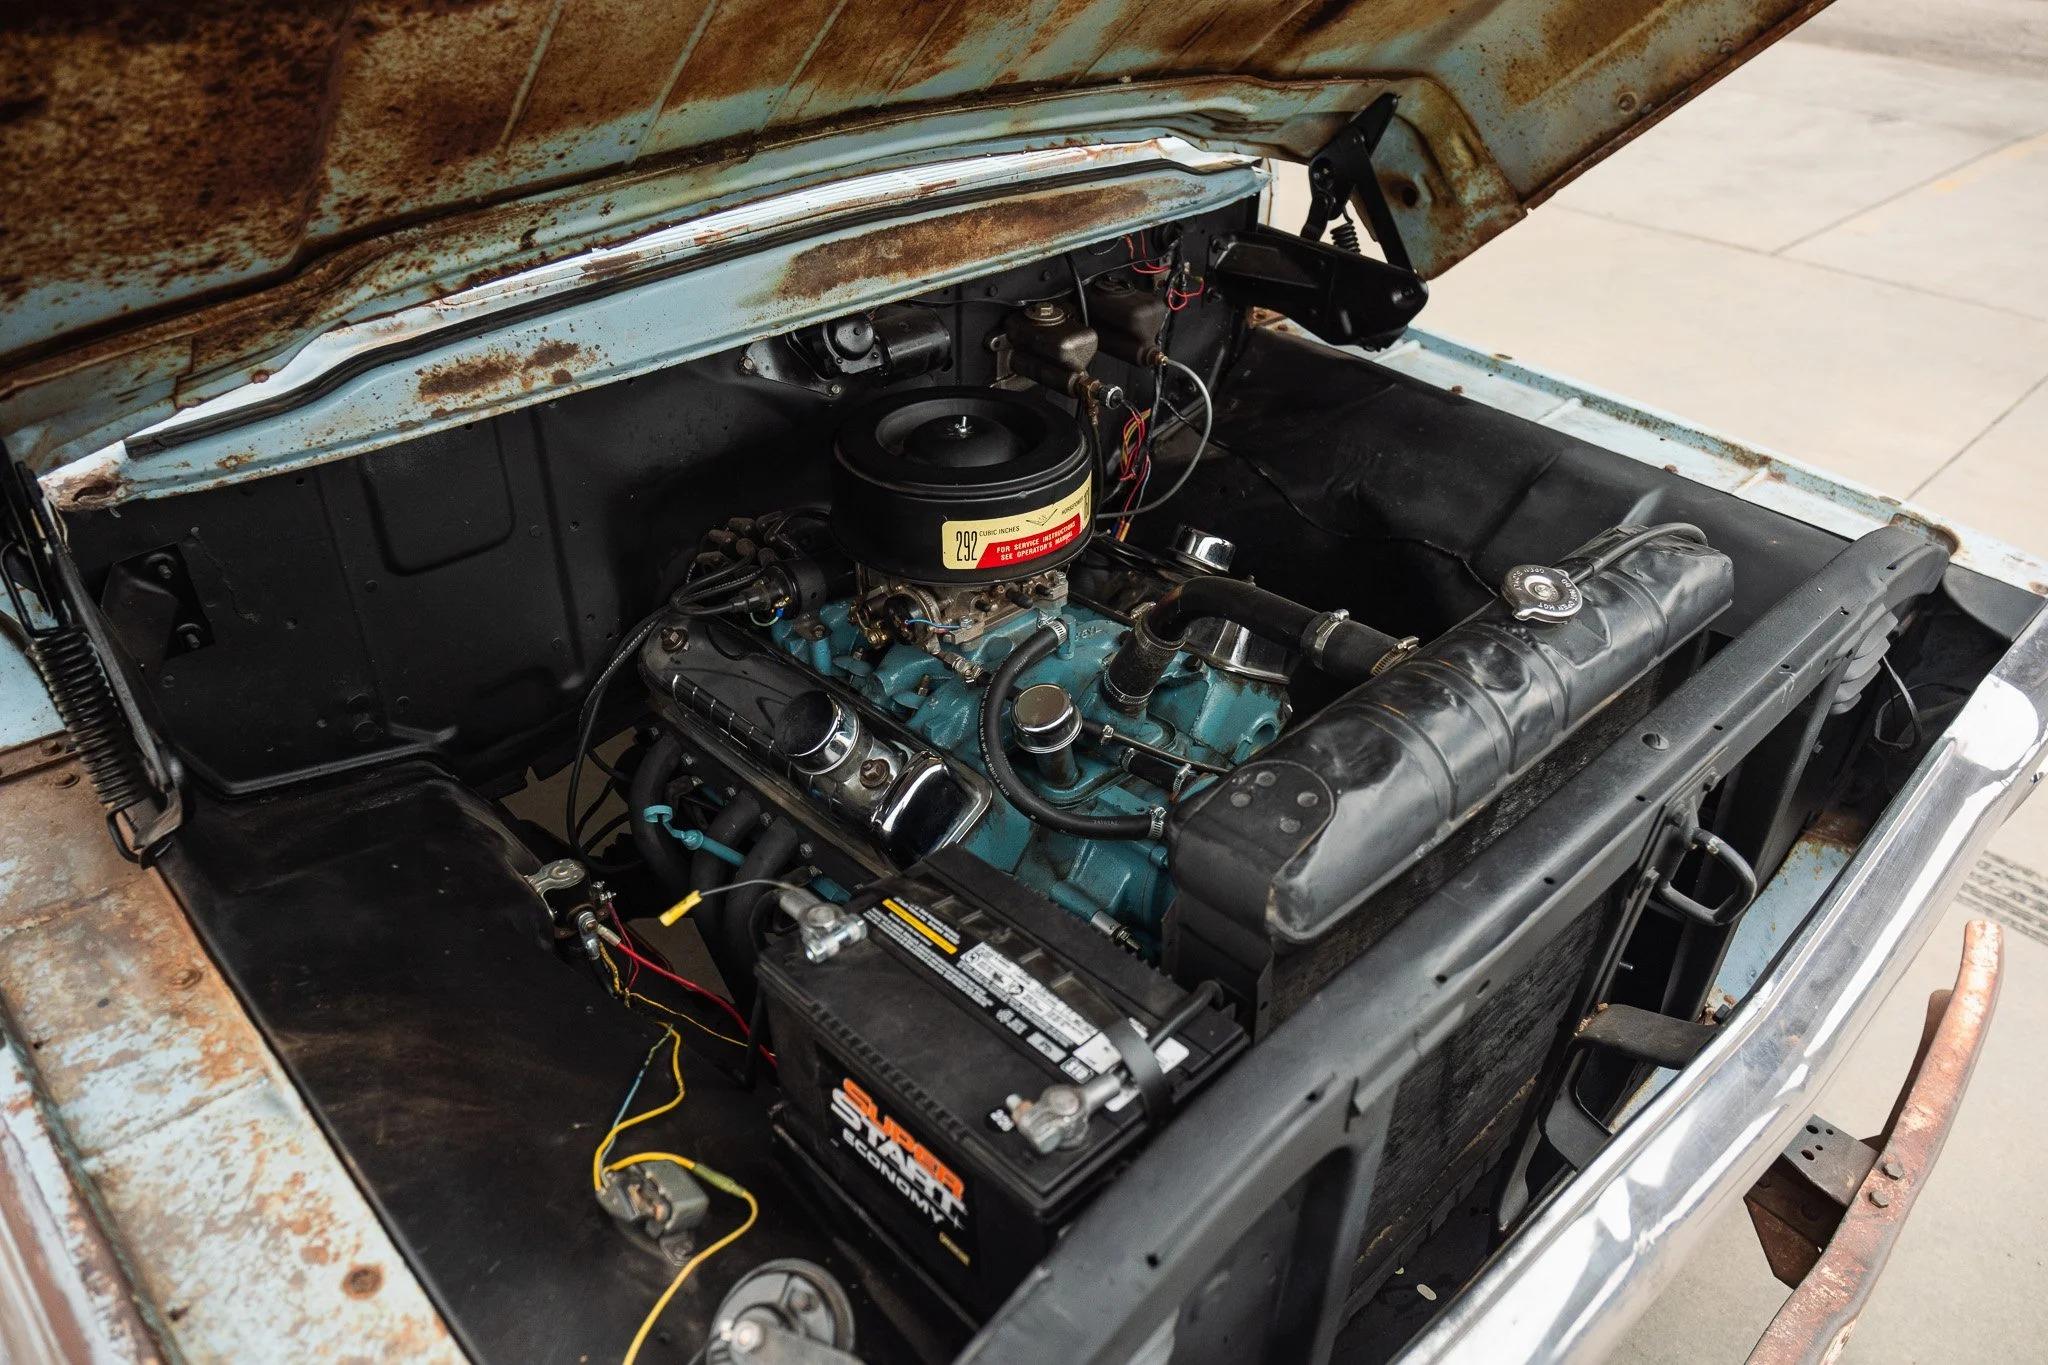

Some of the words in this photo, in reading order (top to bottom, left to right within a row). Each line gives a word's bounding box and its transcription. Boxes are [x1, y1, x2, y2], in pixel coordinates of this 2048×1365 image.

[956, 531, 978, 561] 292
[979, 529, 998, 537] CUBIC
[998, 525, 1020, 535] INCHES
[996, 546, 1011, 554] FOR
[1014, 539, 1040, 551] SERVICE
[1043, 521, 1076, 543] INSTRUCTIONS
[1000, 553, 1013, 561] SEE
[1016, 543, 1053, 558] OPERATOR'S
[1561, 578, 1572, 588] DO
[1538, 602, 1555, 610] HOT
[831, 1088, 967, 1215] START
[843, 1078, 964, 1200] SUPER
[843, 1128, 944, 1224] ECONOMY
